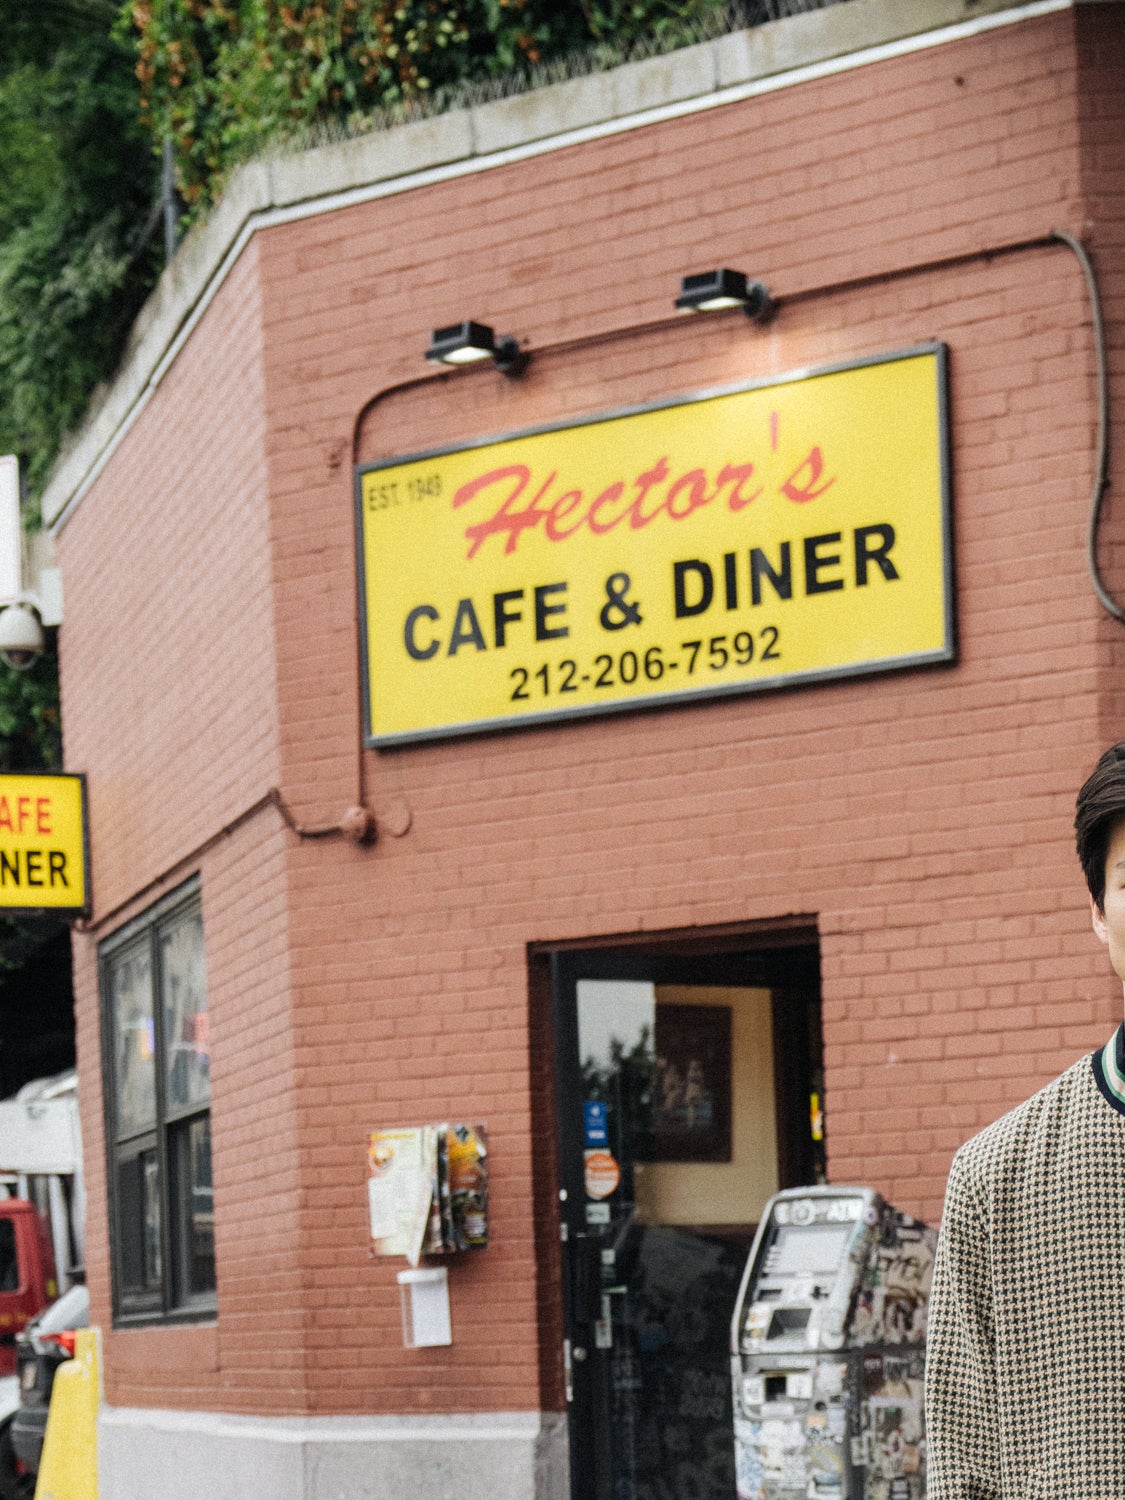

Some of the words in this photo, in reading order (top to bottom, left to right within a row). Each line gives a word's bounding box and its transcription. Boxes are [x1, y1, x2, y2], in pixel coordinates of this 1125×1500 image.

[452, 411, 836, 560] Hector's
[403, 581, 569, 662] CAFE
[599, 572, 643, 632] &
[673, 522, 900, 619] DINER
[509, 626, 781, 702] 212-206-7592
